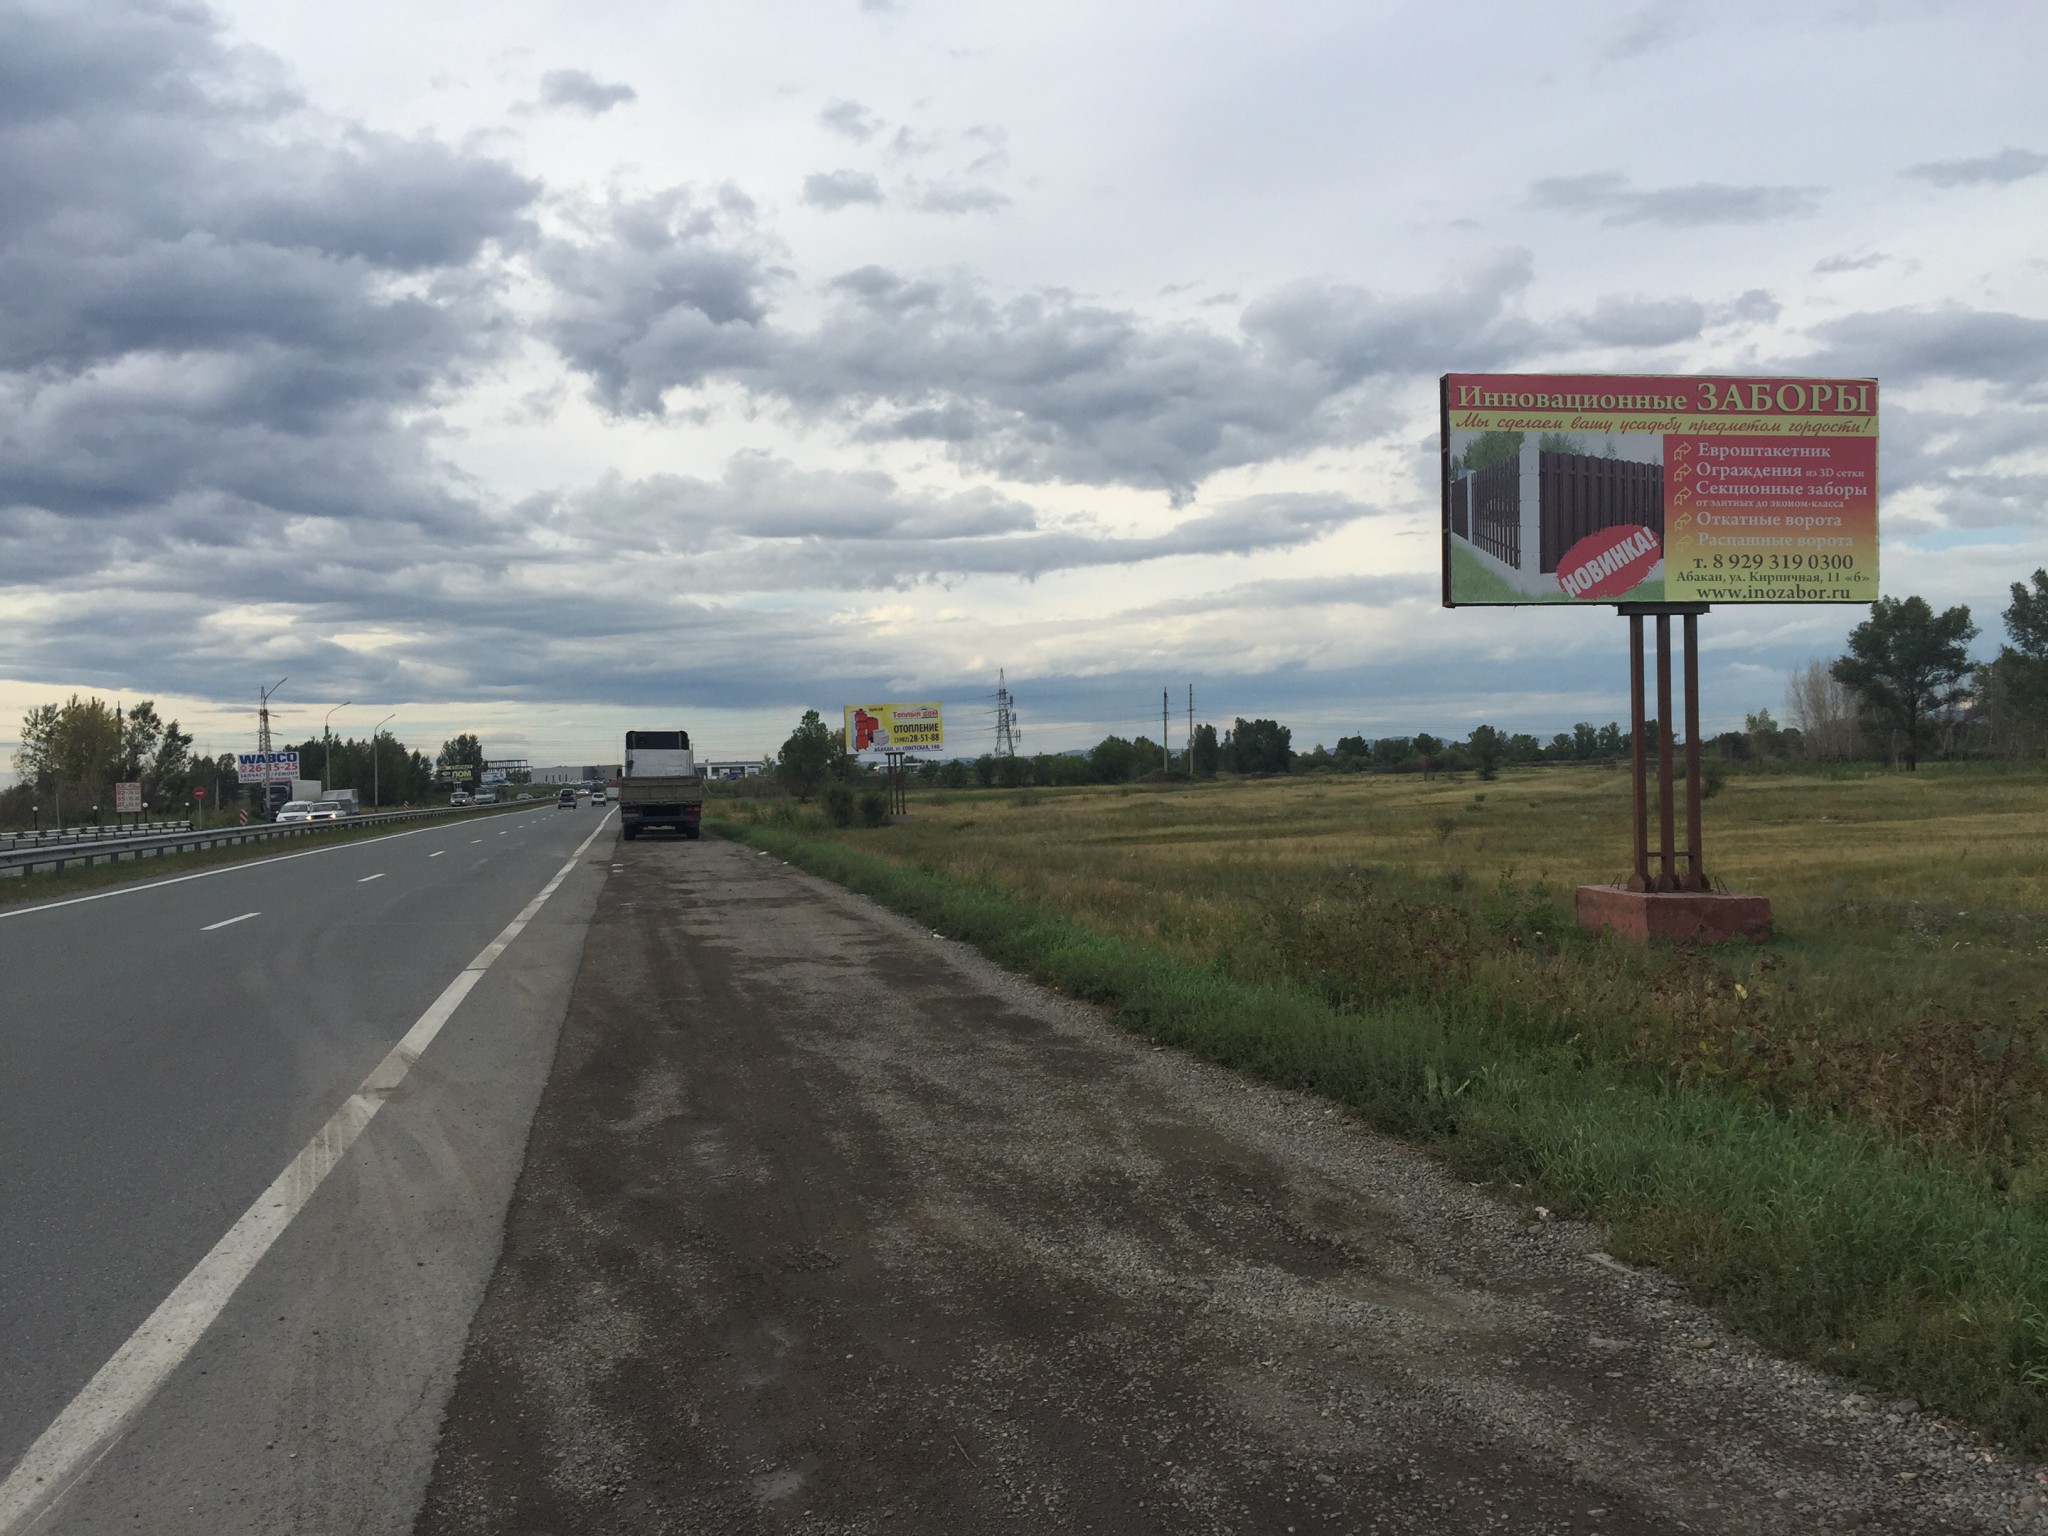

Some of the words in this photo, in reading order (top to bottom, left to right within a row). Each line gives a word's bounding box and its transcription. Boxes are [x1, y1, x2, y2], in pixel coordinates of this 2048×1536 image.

[1458, 385, 1688, 412] Инновационные
[1696, 382, 1870, 412] ЗАБОРЫ
[1456, 412, 1488, 428] Мы
[1497, 417, 1563, 432] сделаем
[1570, 416, 1613, 432] вашу
[1620, 416, 1682, 435] усадьбу
[1689, 419, 1781, 435] предметом
[1789, 418, 1871, 436] гордости!
[1698, 442, 1831, 460] Евроштакетник
[1696, 462, 1802, 480] Ограждения
[1820, 468, 1834, 477] 3D
[1836, 470, 1865, 478] сетки
[1696, 481, 1803, 496] Секционные
[1807, 482, 1867, 499] заборы
[1756, 500, 1768, 508] до
[1770, 500, 1844, 508] эконом-класса
[1696, 512, 1781, 526] Откатные
[1785, 515, 1841, 531] ворота
[1698, 532, 1792, 547] Распашные
[1798, 536, 1853, 550] ворота
[1561, 526, 1659, 598] НОВИНКА!
[1693, 559, 1706, 569] т.
[1713, 554, 1723, 569] 8
[1729, 554, 1764, 569] 929
[1769, 554, 1803, 569] 319
[1808, 554, 1853, 569] 0300
[1676, 572, 1725, 583] Абакан,
[1729, 575, 1745, 584] ул.
[1749, 572, 1823, 585] Кирпичная,
[1827, 572, 1840, 582] 11
[1696, 585, 1850, 599] www.inozabor.ru
[894, 723, 938, 733] ОТОПЛЕНИЕ
[239, 753, 297, 764] WABCO
[249, 763, 298, 772] 26-15-25
